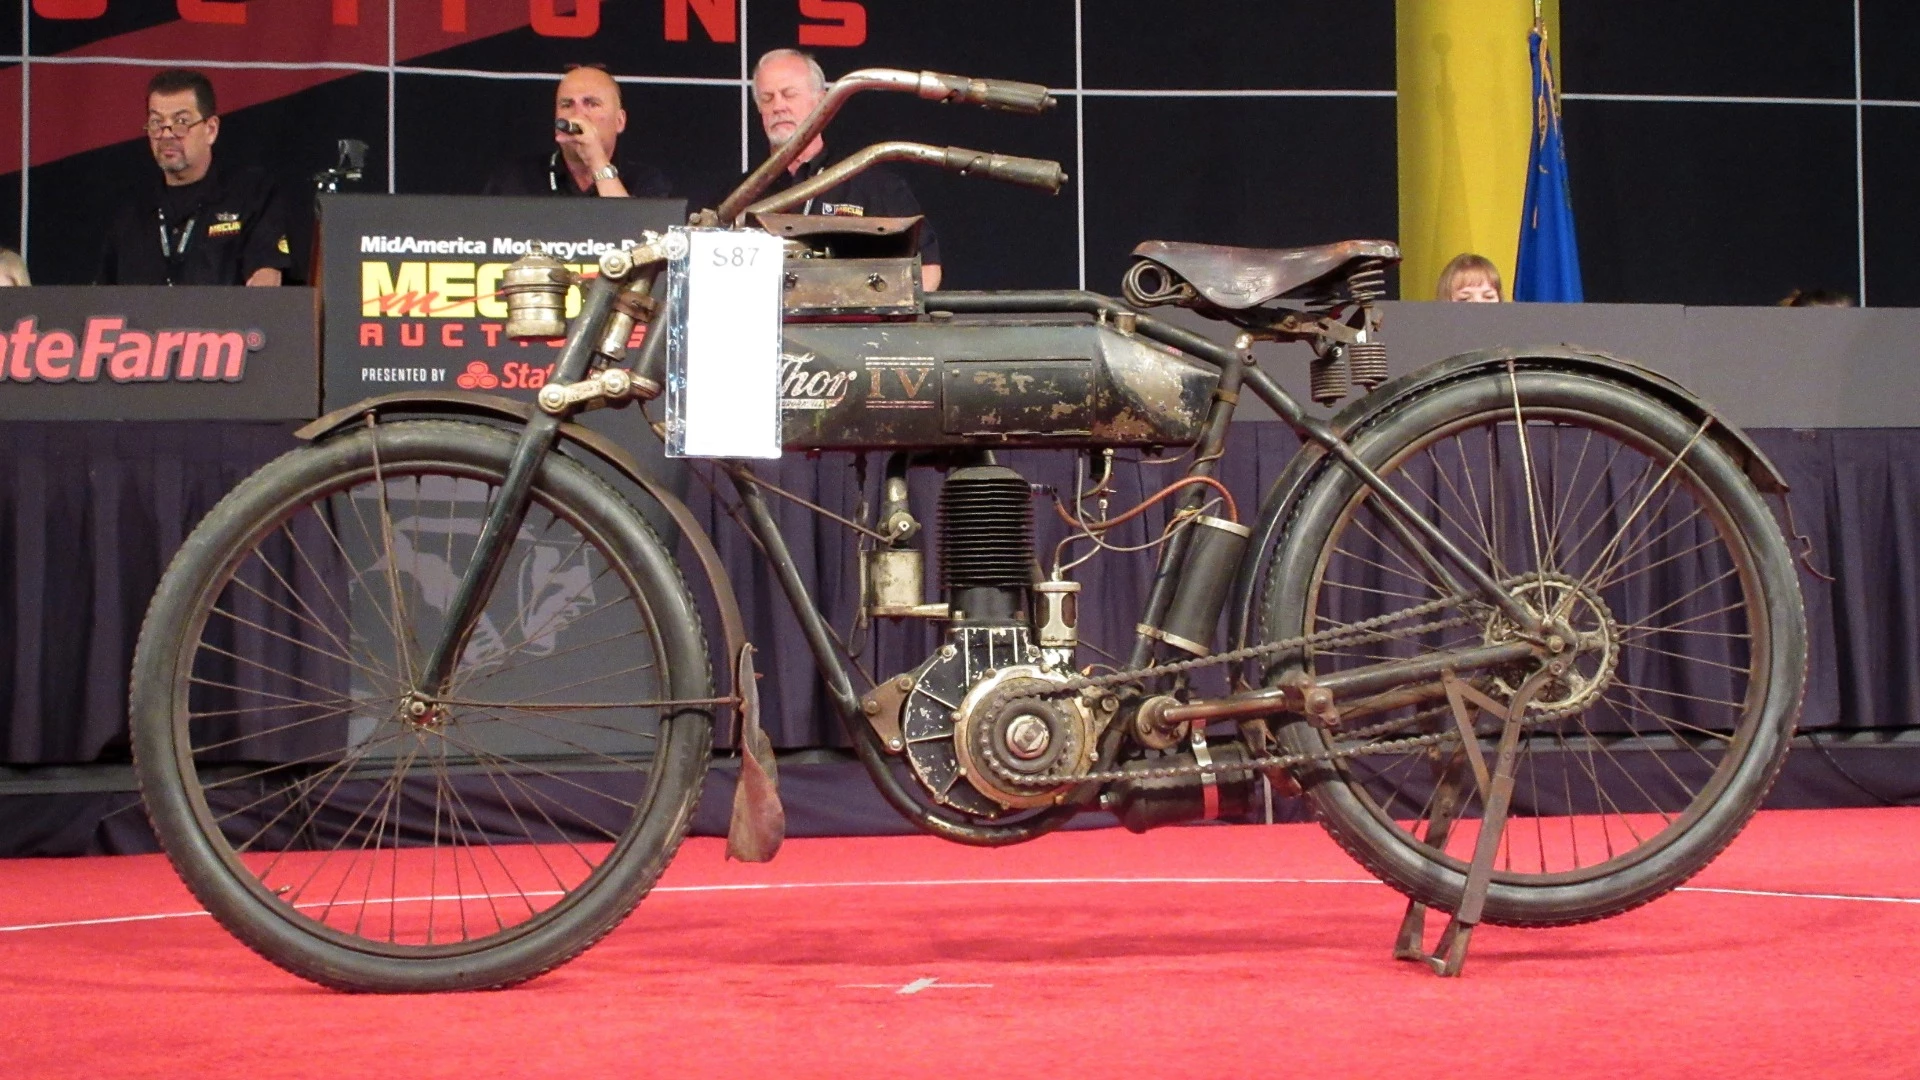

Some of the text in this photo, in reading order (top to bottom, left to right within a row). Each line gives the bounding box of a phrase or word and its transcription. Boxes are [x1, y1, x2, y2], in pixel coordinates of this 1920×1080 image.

[360, 236, 487, 254] MidAmerica
[712, 246, 760, 267] S87
[361, 367, 446, 382] PRESENTED BY
[780, 352, 935, 400] Thor IV
